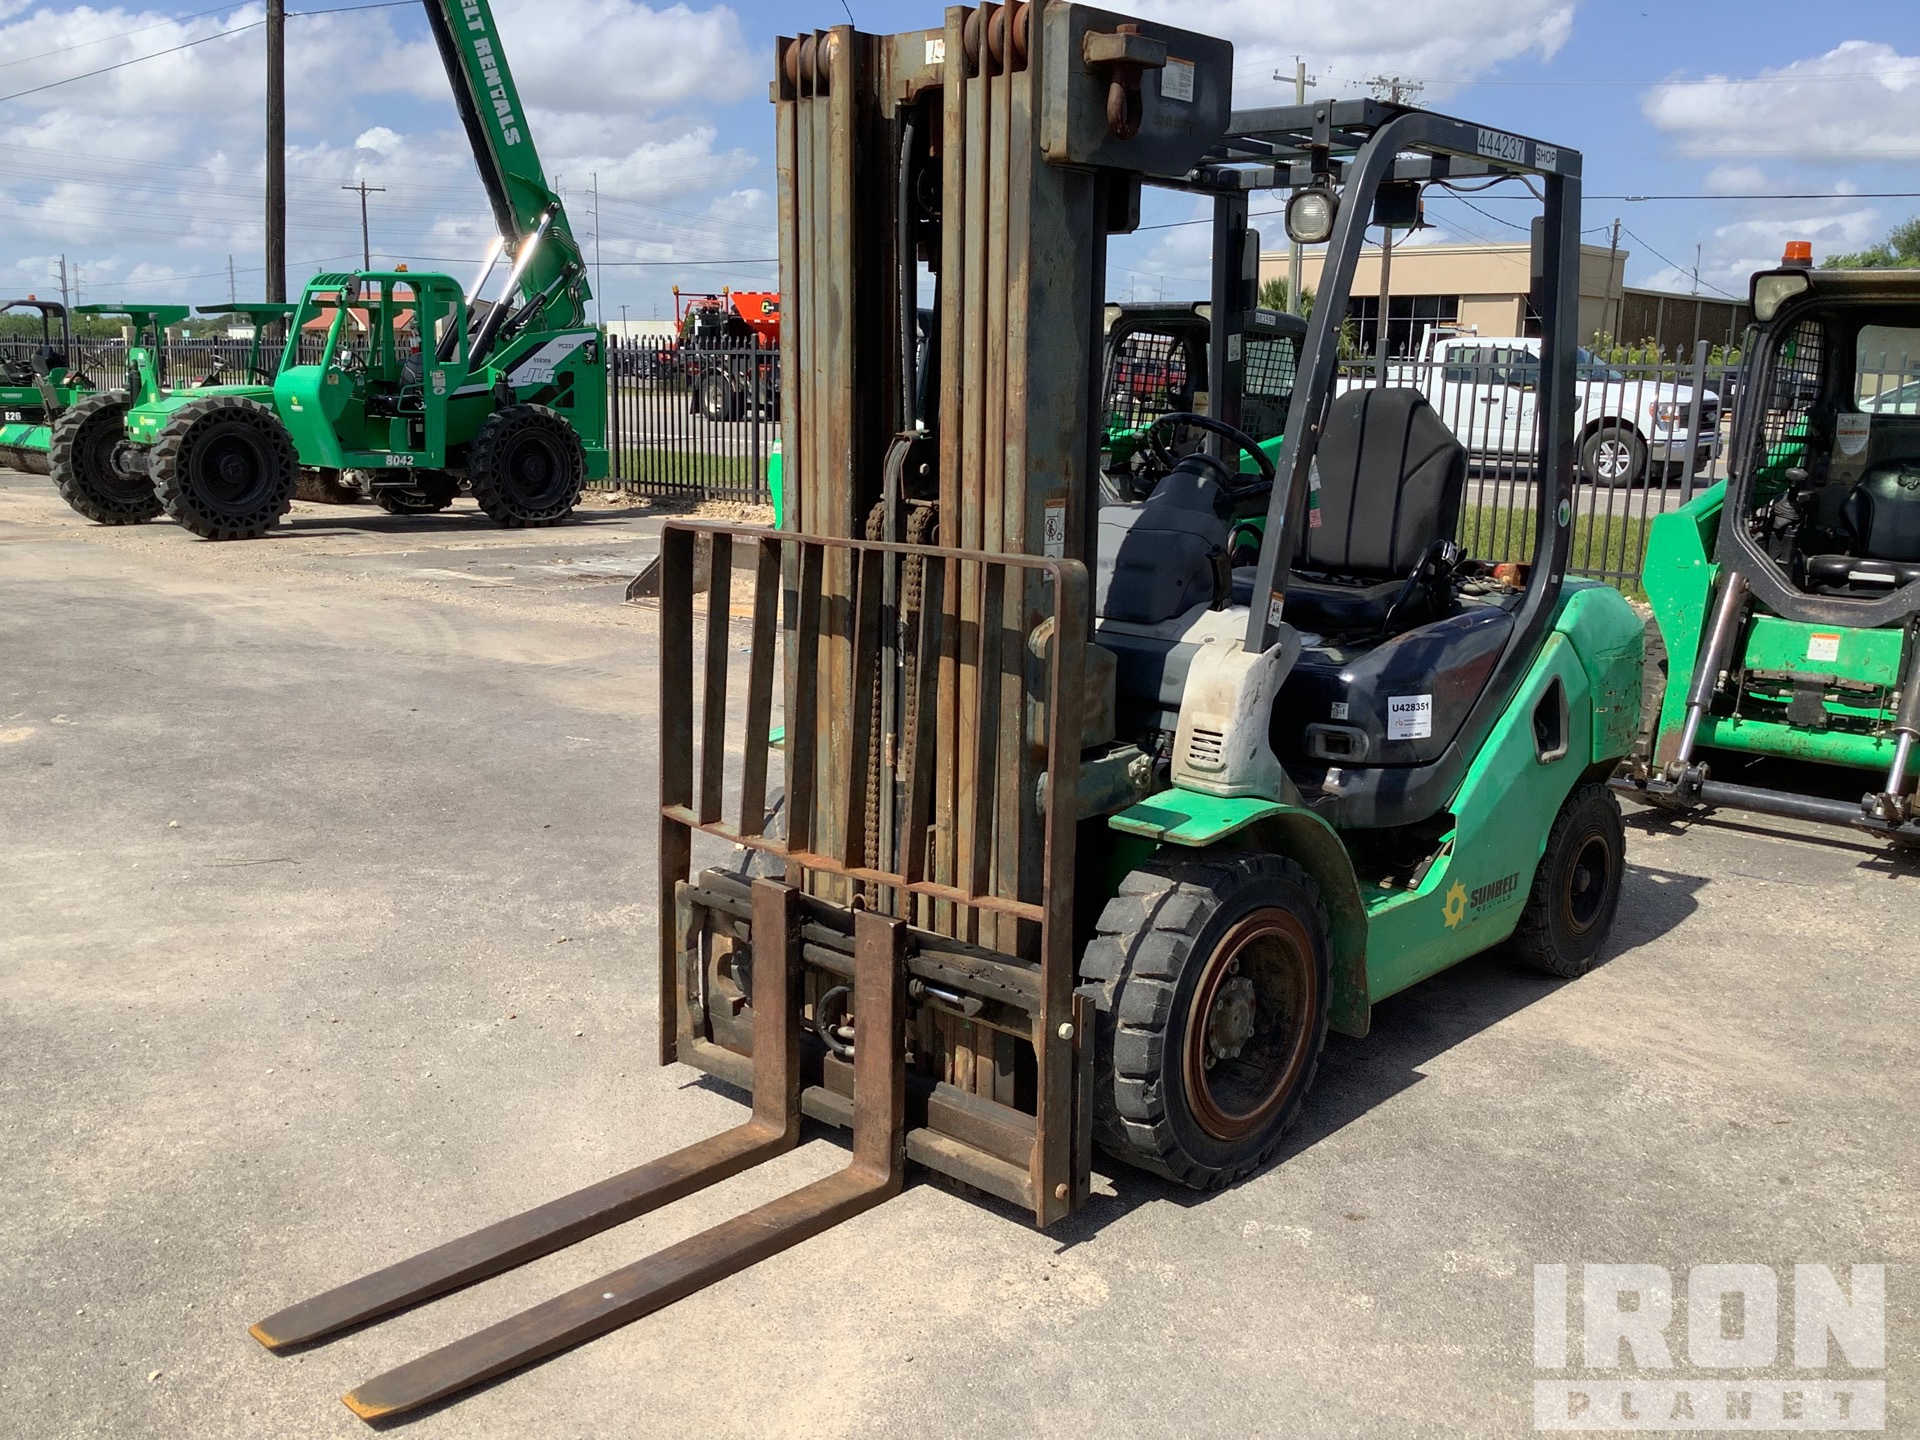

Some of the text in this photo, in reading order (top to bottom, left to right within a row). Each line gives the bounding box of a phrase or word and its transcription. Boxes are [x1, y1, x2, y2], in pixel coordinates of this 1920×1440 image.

[473, 37, 521, 146] RENTALS
[1478, 130, 1556, 164] 444237 SHOP
[522, 367, 555, 383] JLG
[4, 411, 22, 421] E26
[385, 454, 414, 466] 8042
[1392, 702, 1429, 713] U428351
[1470, 871, 1520, 909] SUNBELT
